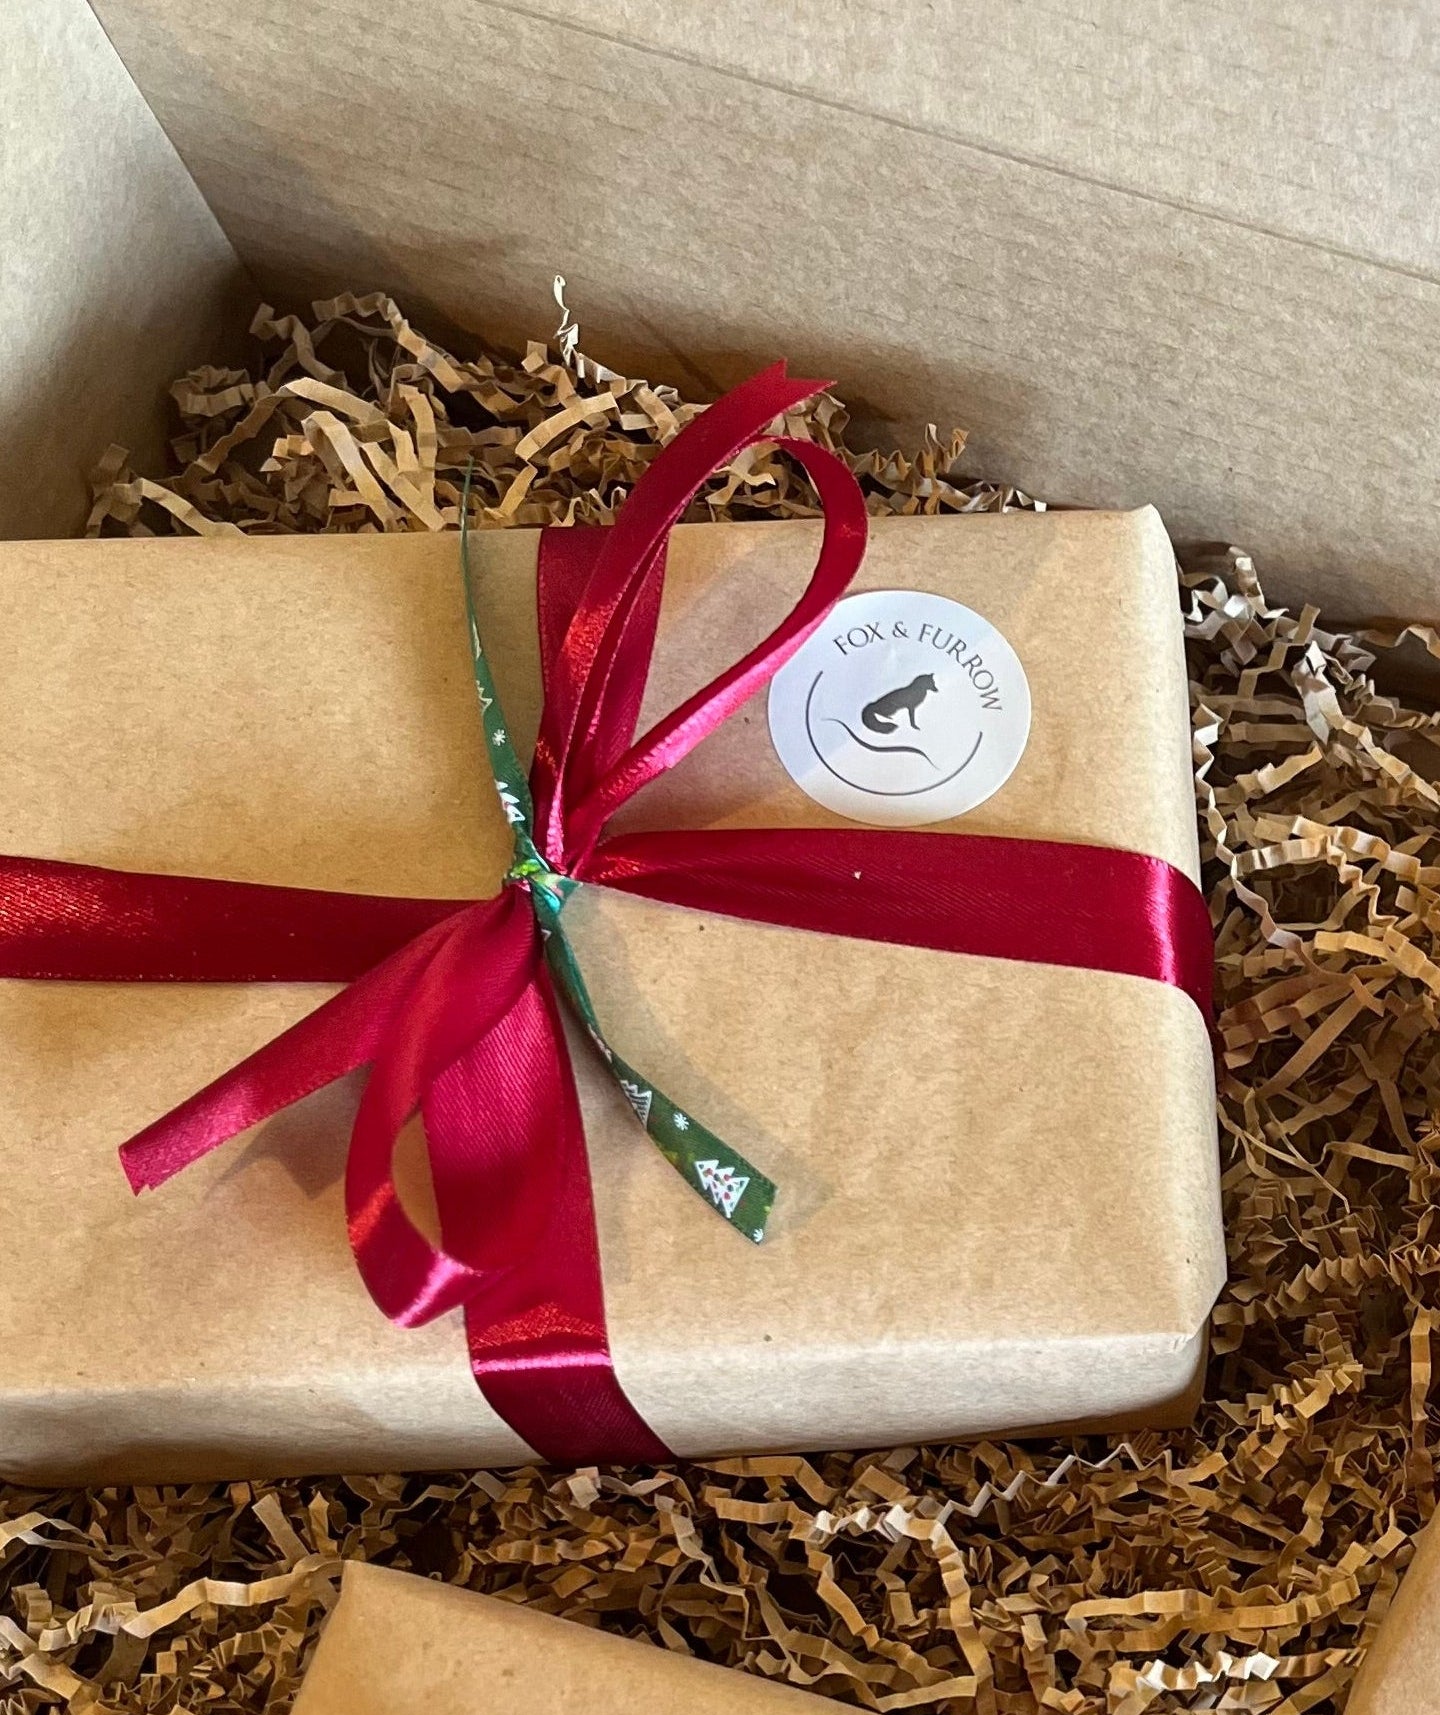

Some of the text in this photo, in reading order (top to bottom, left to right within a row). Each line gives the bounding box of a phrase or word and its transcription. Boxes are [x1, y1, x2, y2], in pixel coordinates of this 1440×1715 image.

[832, 620, 1003, 711] FOX & FURROW
